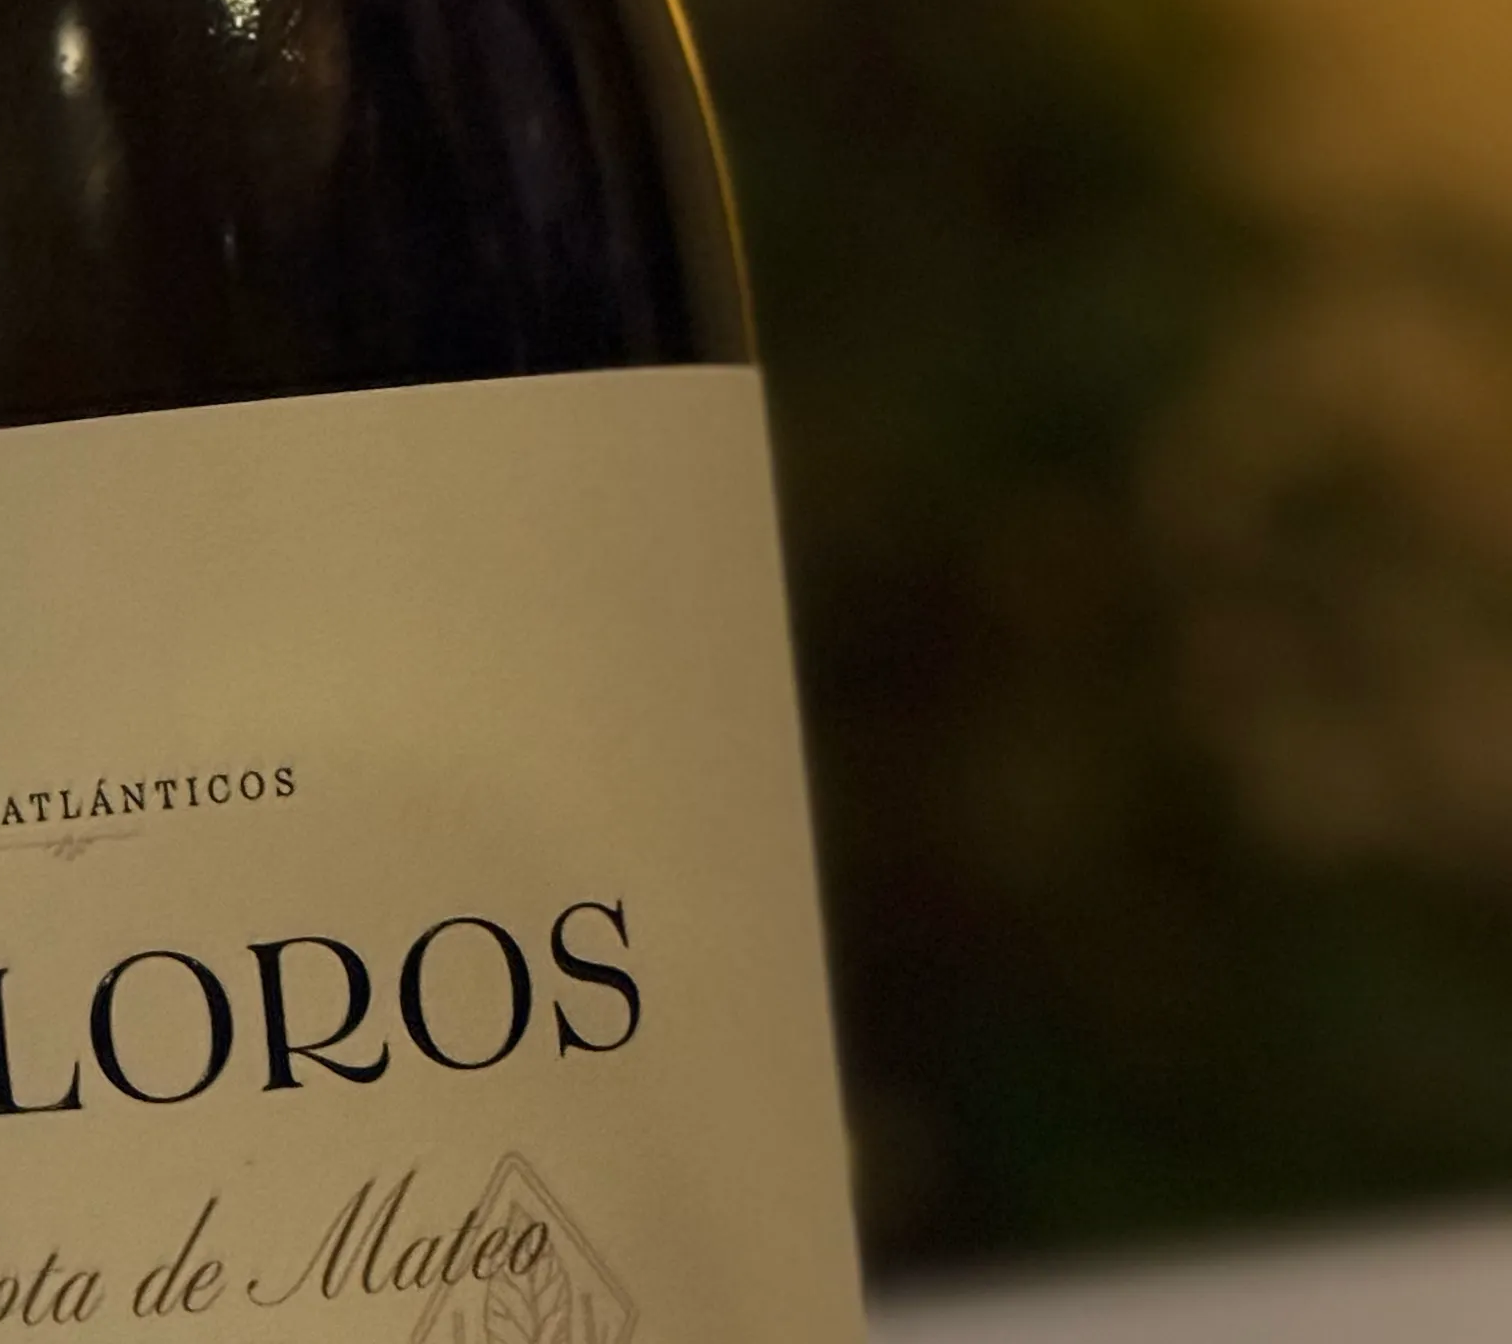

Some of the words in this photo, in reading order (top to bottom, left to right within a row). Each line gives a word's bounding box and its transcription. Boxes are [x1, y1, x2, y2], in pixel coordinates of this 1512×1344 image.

[0, 766, 299, 826] ATLÁNTICOS
[131, 1196, 226, 1318] de
[247, 1164, 550, 1308] Mateo
